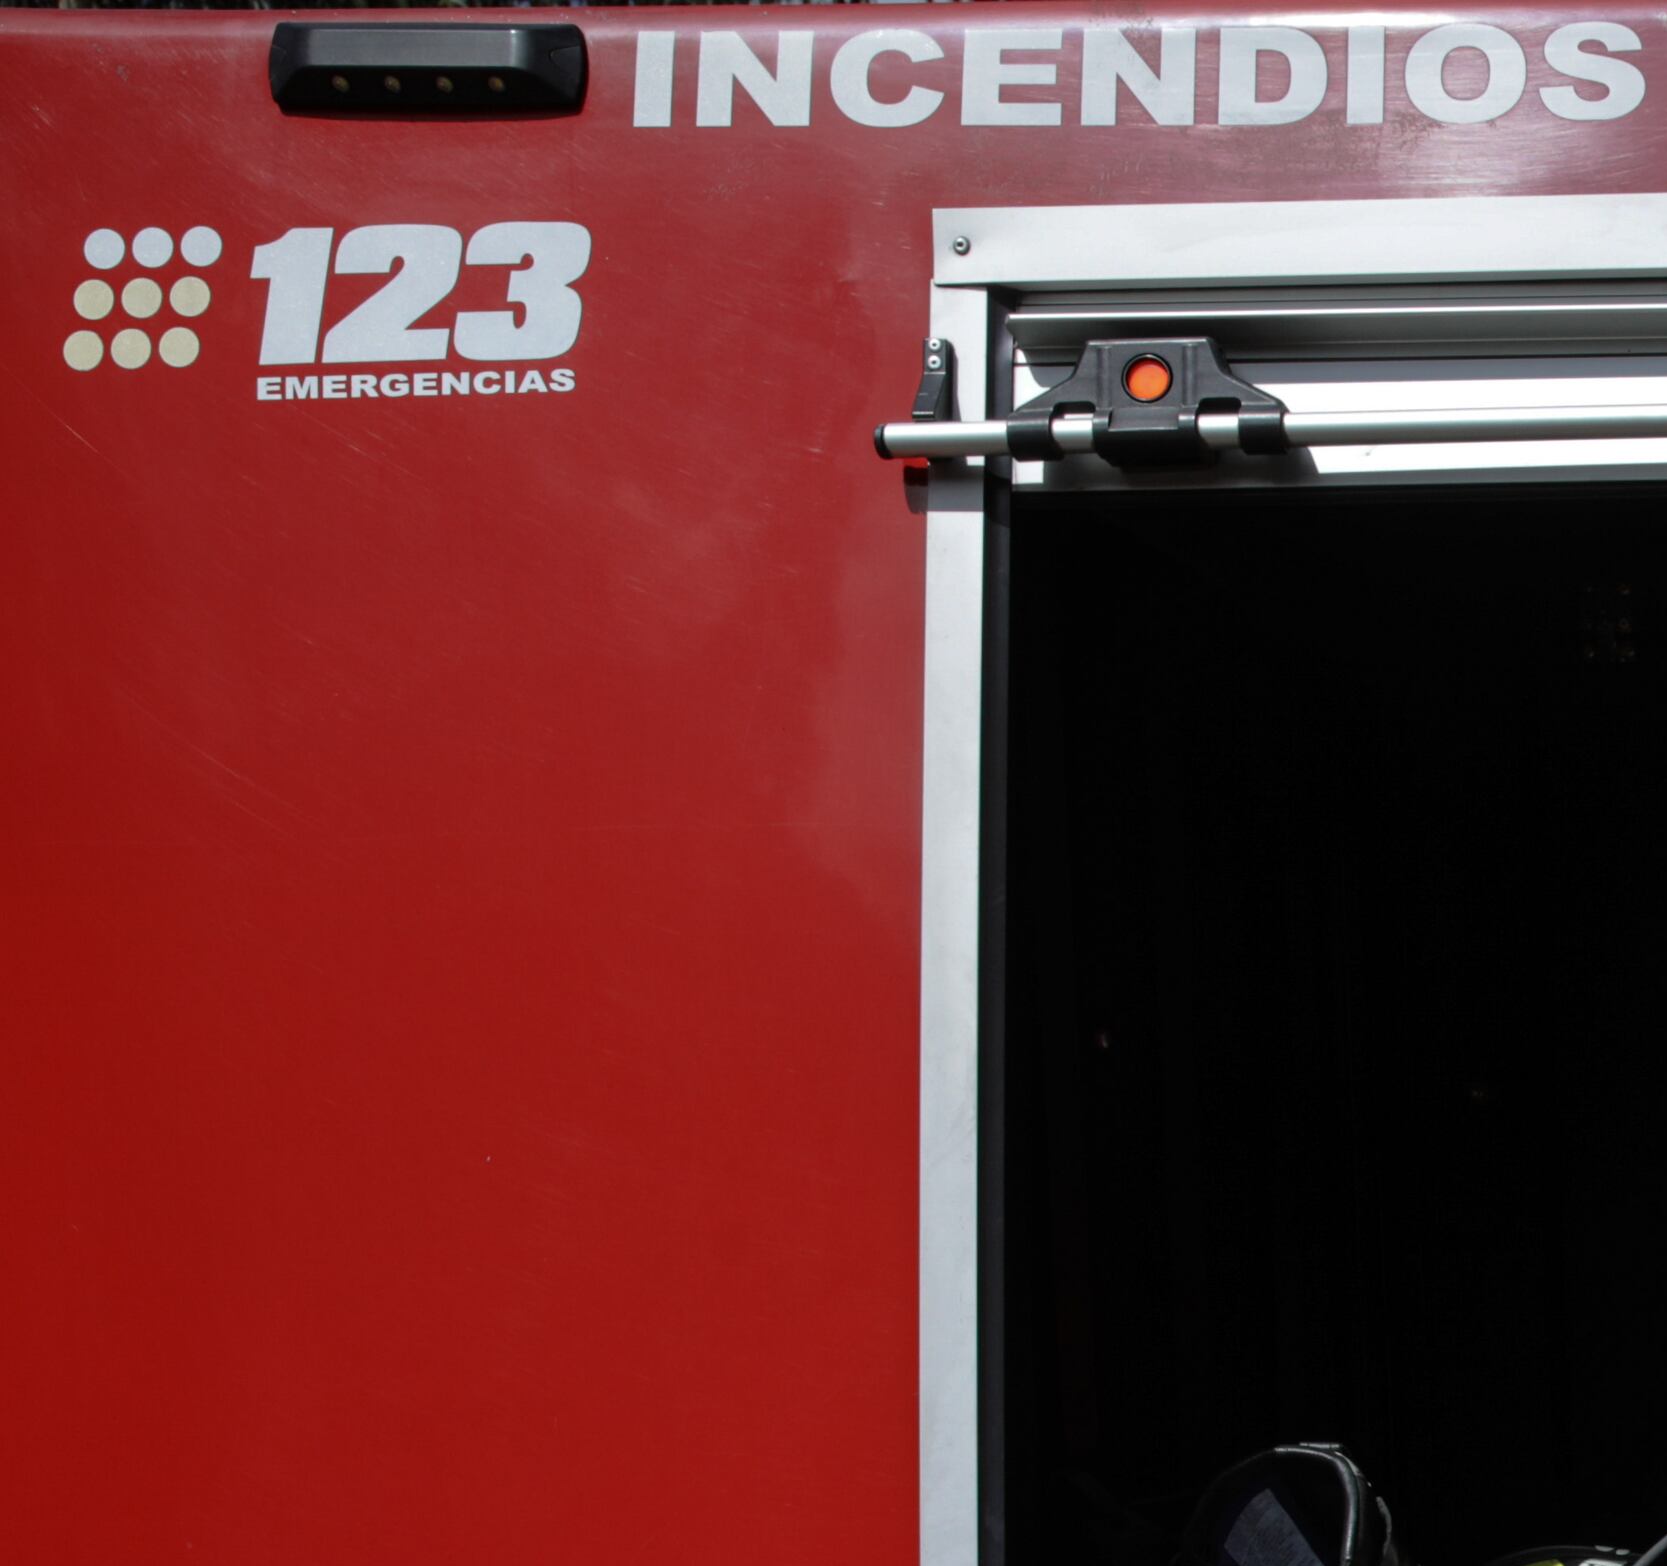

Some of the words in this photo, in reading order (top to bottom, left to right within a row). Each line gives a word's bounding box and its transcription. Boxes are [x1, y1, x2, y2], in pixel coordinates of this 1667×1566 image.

[632, 21, 1647, 128] INCENDIOS
[250, 221, 592, 366] 123
[256, 368, 576, 401] EMERGENCIAS
